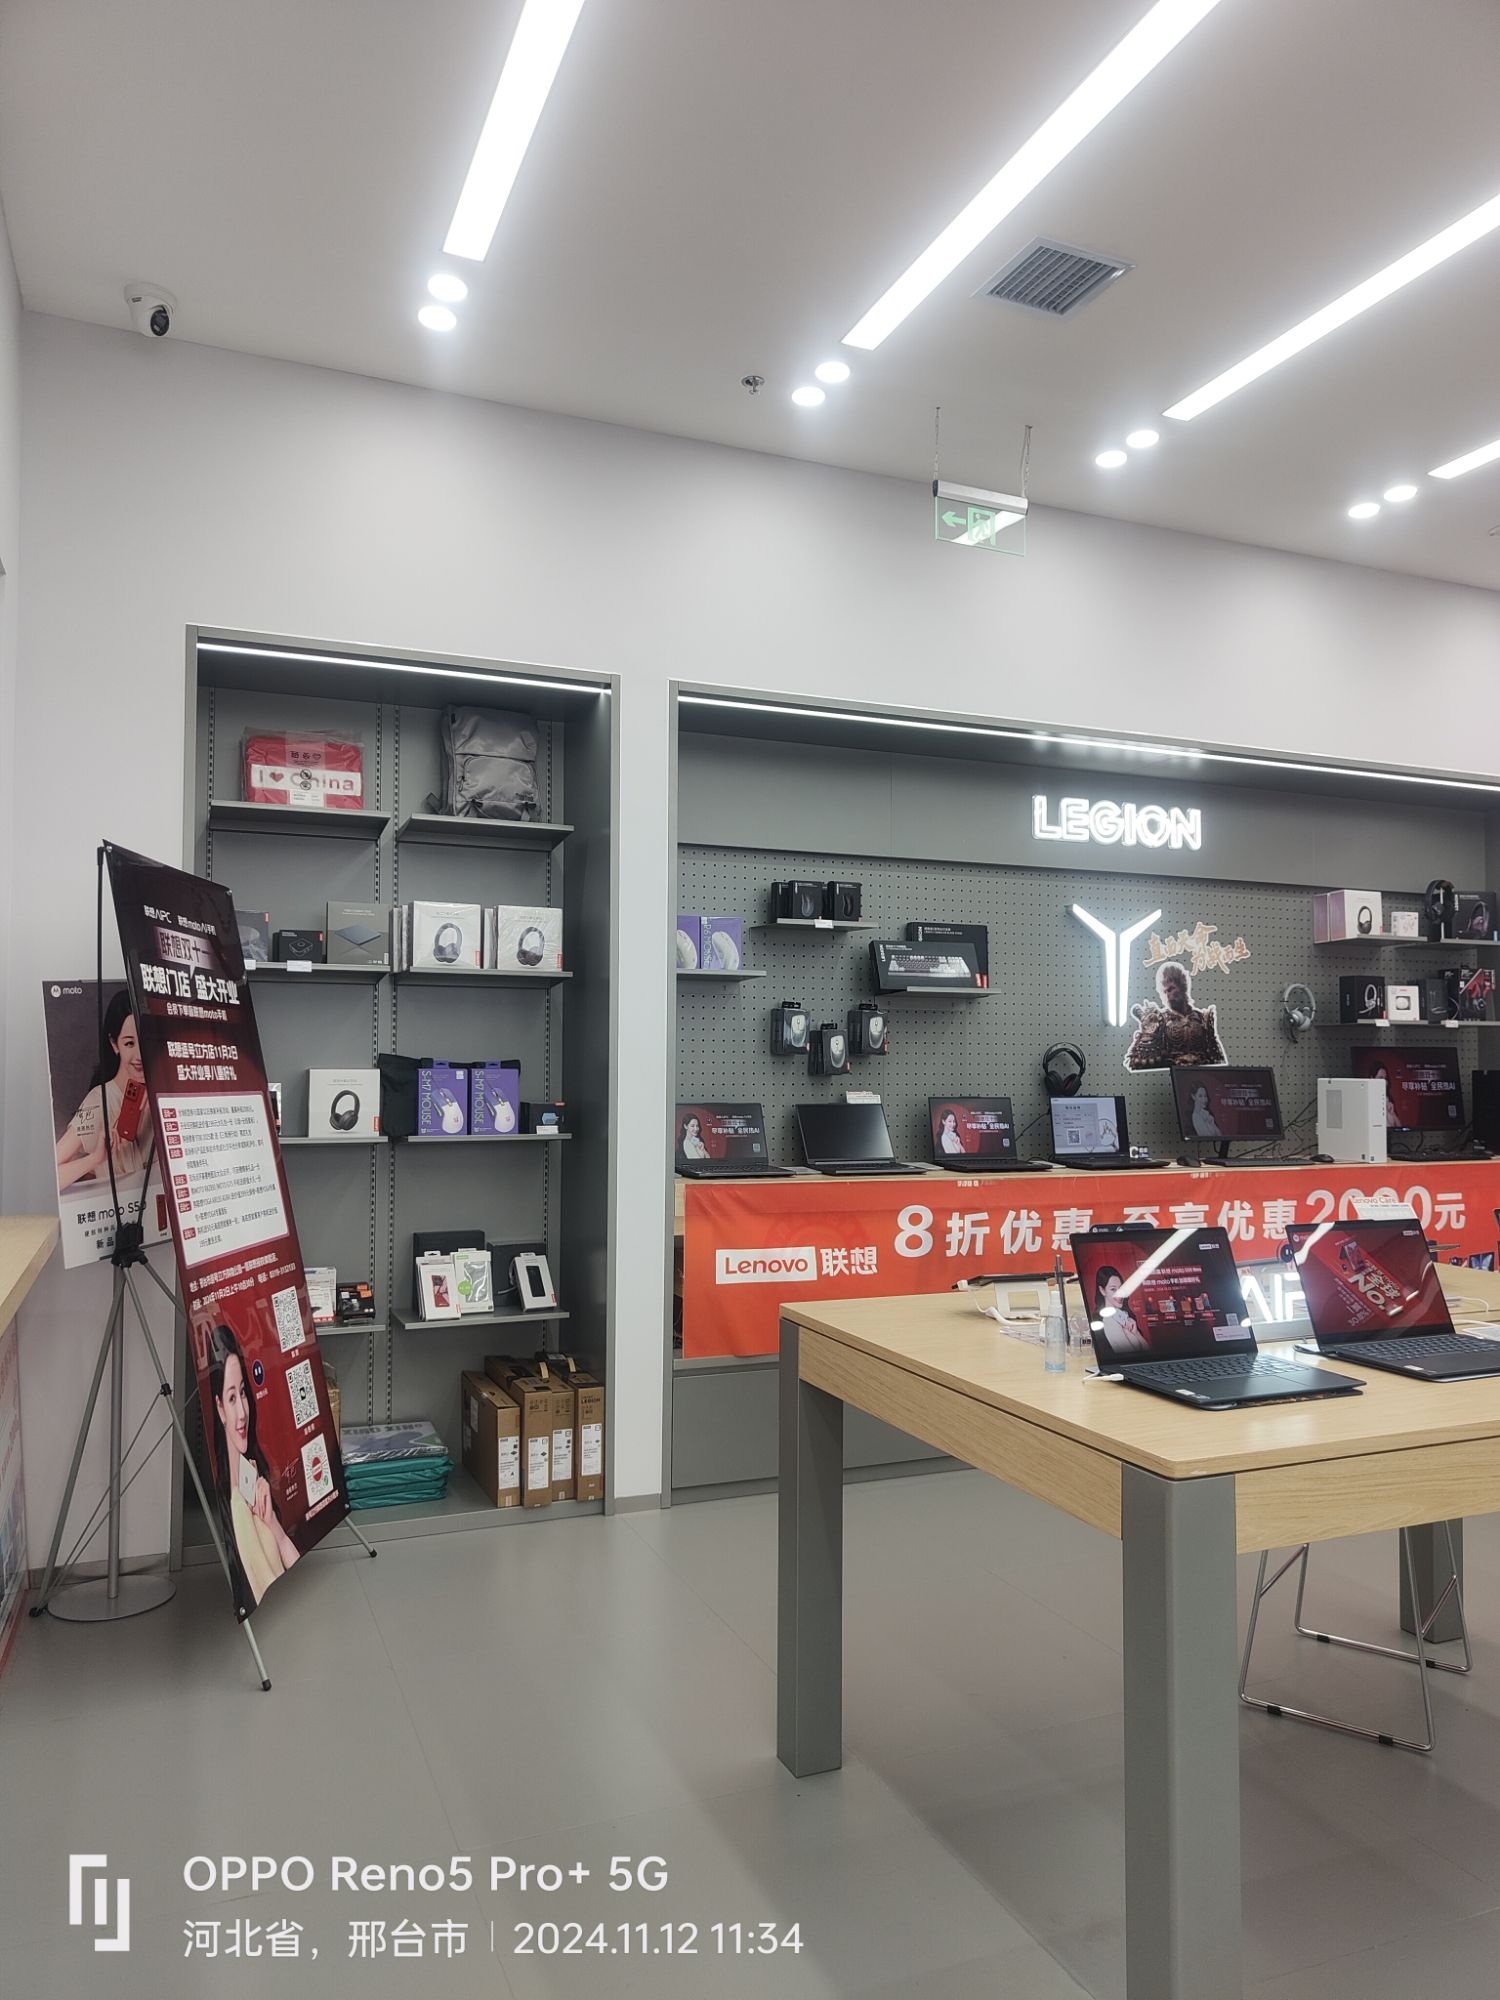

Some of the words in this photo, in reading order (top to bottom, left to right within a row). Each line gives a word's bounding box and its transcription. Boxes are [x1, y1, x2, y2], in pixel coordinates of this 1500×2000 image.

[1032, 795, 1202, 850] LEGION
[140, 963, 191, 997] 联想门店
[195, 974, 240, 1004] 盛大开业
[422, 1093, 432, 1125] MOUSE
[475, 1092, 485, 1124] MOUSE
[77, 1210, 97, 1224] 联想
[99, 1207, 125, 1221] moo
[894, 1205, 1094, 1257] 8折优惠
[725, 1256, 809, 1276] Lenovo
[820, 1246, 878, 1277] 联想
